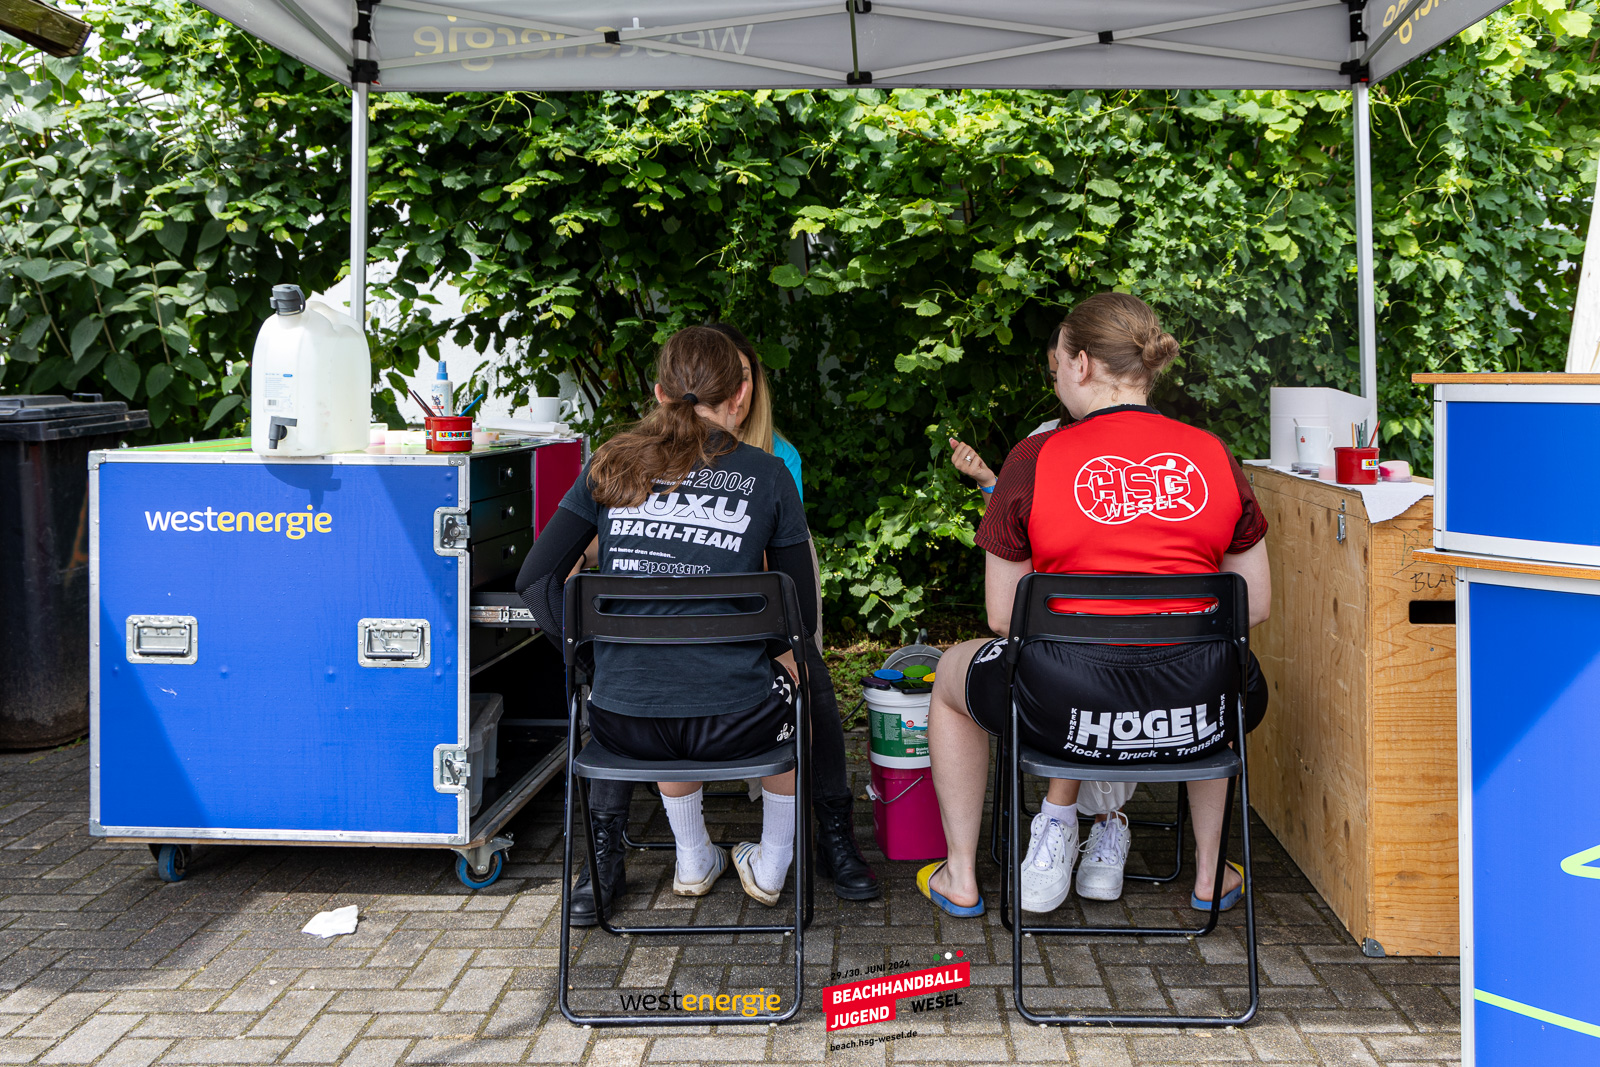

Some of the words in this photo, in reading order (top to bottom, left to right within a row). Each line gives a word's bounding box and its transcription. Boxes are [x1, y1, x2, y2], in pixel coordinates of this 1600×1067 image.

[693, 468, 756, 496] 2004
[1091, 464, 1191, 505] HSG
[144, 504, 333, 540] westenergie
[1103, 495, 1178, 518] WESEL
[609, 519, 743, 553] BEACH-TEAM
[1066, 707, 1078, 741] KEMPEN
[1075, 703, 1217, 749] HÖGEL
[1063, 742, 1102, 759] Flock
[1117, 750, 1158, 761] Druck
[1176, 729, 1226, 757] Transfer
